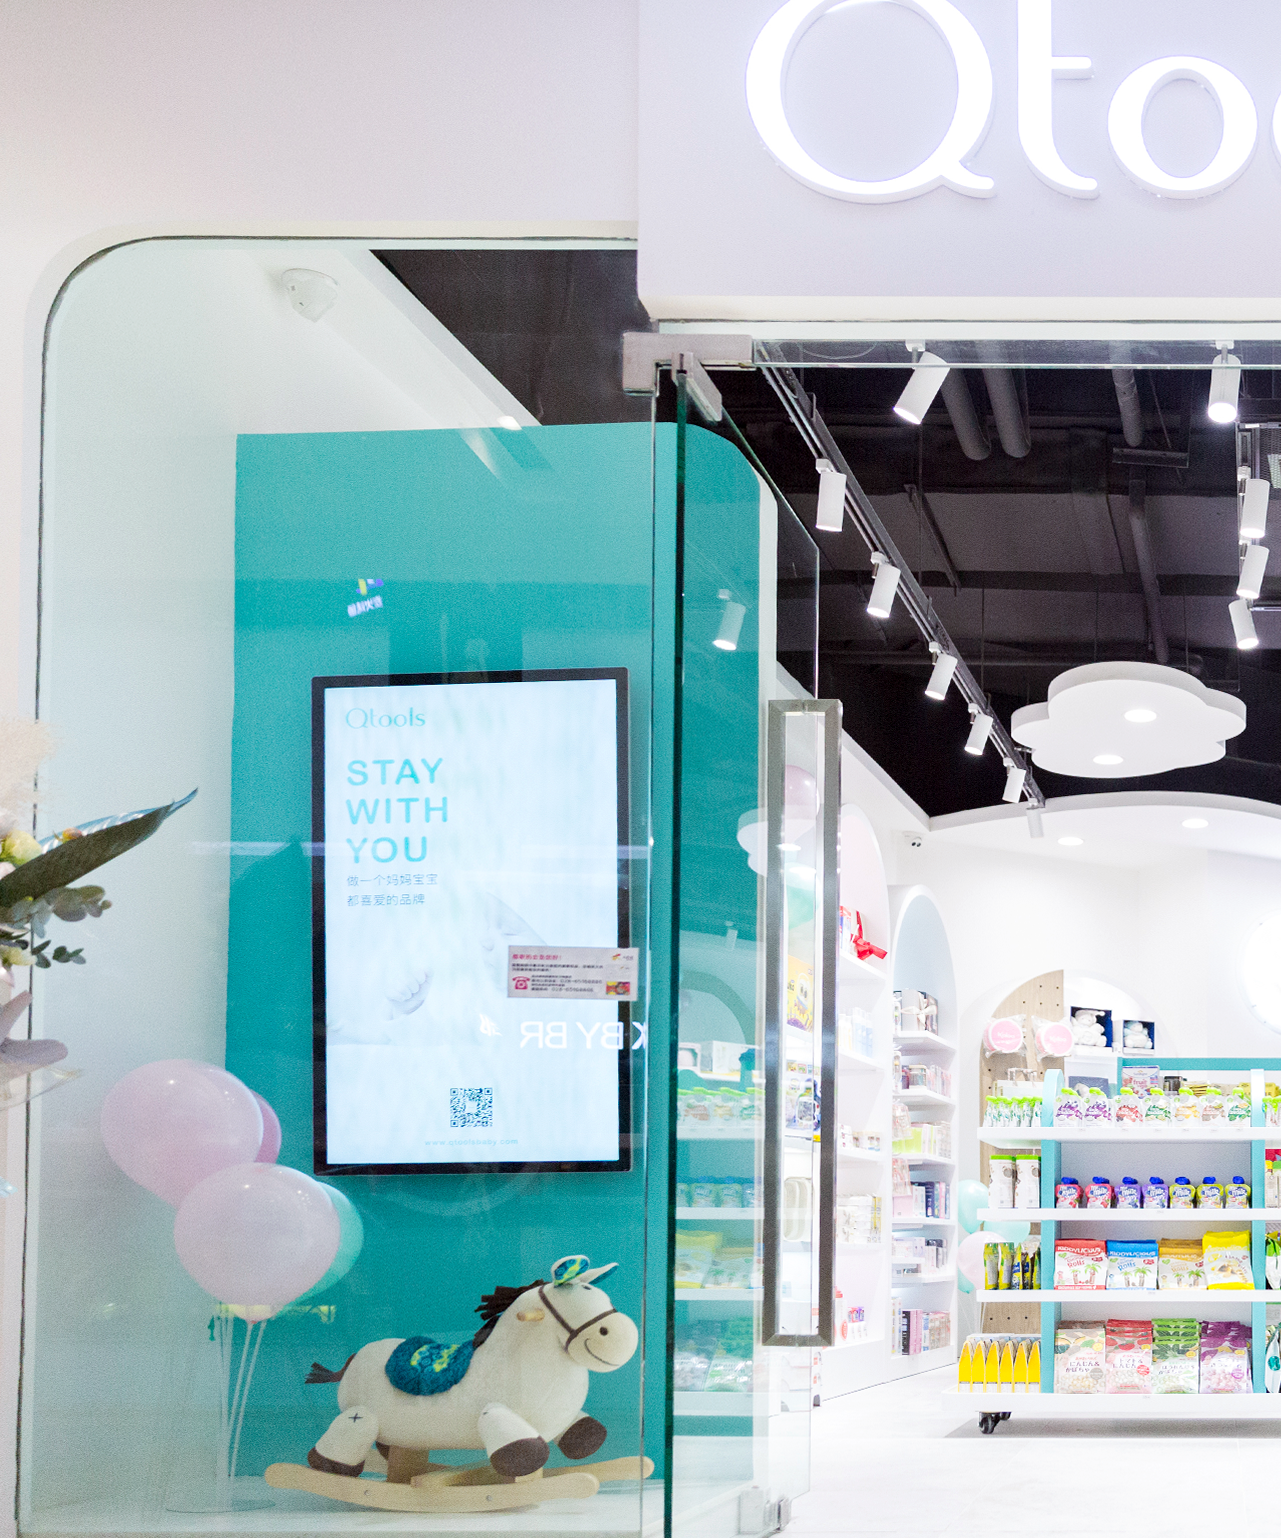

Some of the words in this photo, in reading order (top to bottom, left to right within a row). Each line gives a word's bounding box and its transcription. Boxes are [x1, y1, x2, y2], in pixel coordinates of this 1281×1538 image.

[345, 706, 426, 729] Qtools
[347, 757, 443, 786] STAY
[345, 796, 448, 825] WITH
[346, 836, 427, 864] YOU
[347, 873, 438, 887] 做一个妈妈宝宝
[347, 893, 425, 907] 都喜爱的品牌
